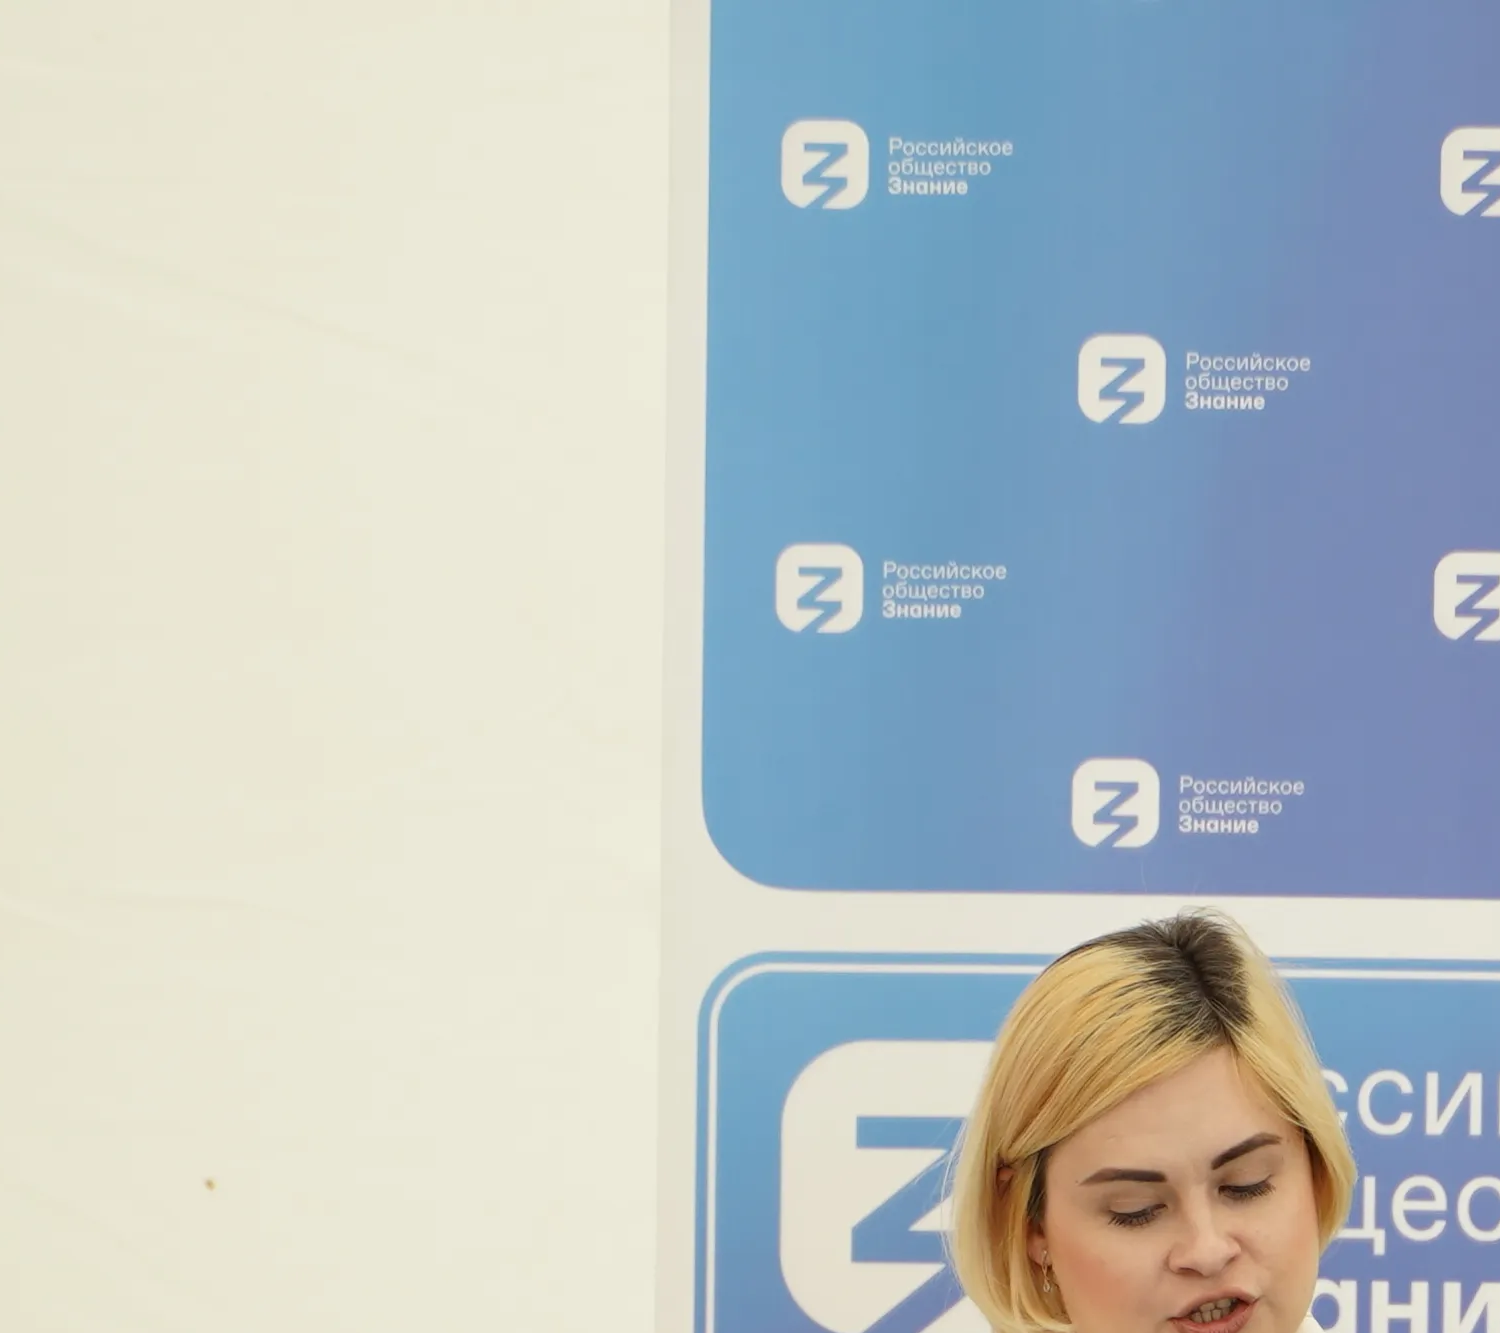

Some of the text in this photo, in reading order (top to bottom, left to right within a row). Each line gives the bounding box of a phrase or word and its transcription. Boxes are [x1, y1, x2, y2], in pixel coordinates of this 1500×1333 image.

[888, 136, 1014, 156] Российское
[887, 157, 992, 177] общество
[887, 175, 969, 194] Знание
[1186, 351, 1311, 371] Российское
[1184, 372, 1289, 392] общество
[1184, 390, 1266, 409] Знание
[883, 559, 1007, 579] Российское
[882, 580, 985, 600] общество
[882, 598, 962, 617] Знание
[1179, 775, 1305, 795] Российское
[1178, 796, 1283, 816] общество
[1178, 814, 1260, 833] Знание
